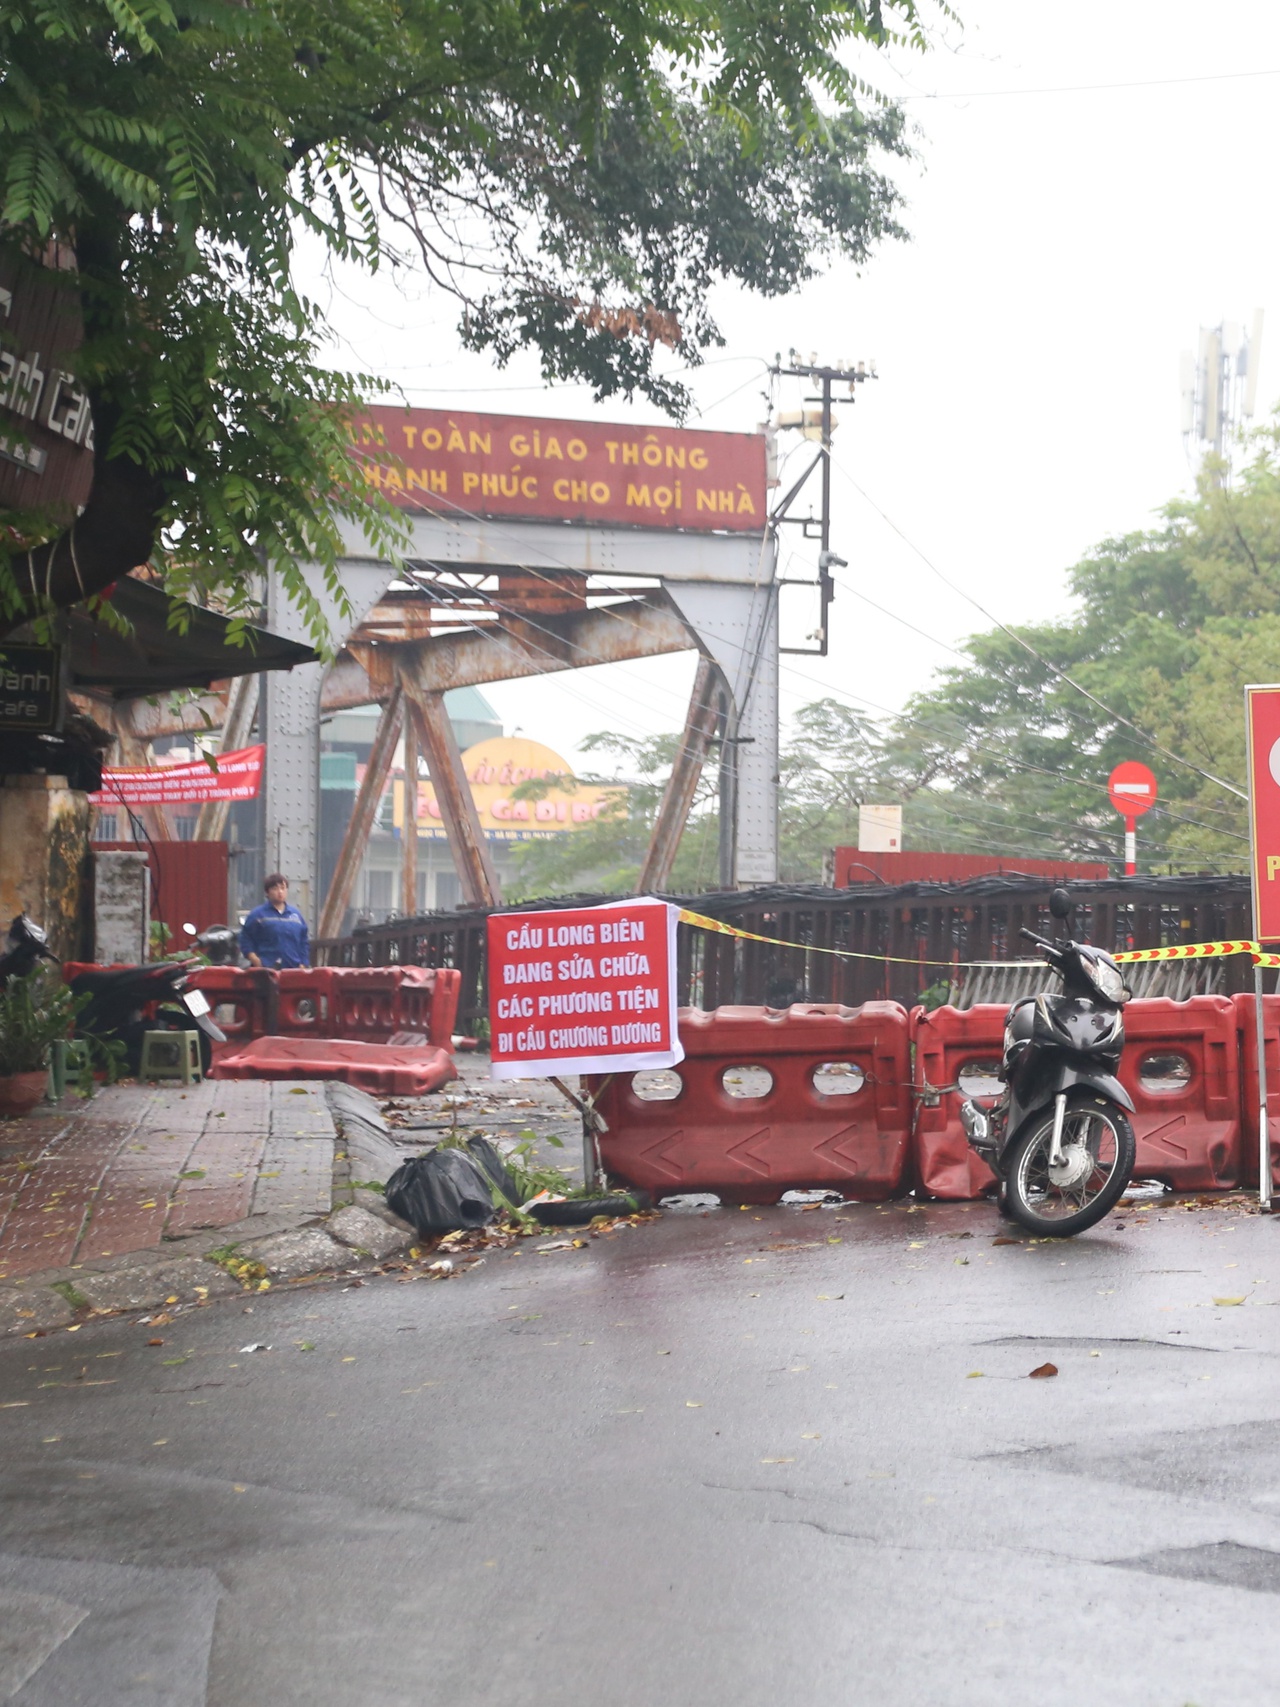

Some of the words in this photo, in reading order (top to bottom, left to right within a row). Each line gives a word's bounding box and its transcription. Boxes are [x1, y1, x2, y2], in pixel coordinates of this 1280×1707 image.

[403, 420, 492, 455] TOÀN
[510, 434, 588, 462] GIAO
[606, 435, 709, 470] THÔNG
[363, 464, 448, 498] HẠNH
[463, 465, 538, 500] PHÚC
[553, 478, 611, 505] CHO
[626, 481, 682, 517] MỌI
[696, 483, 757, 516] NHÀ
[507, 922, 543, 950] CẦU
[548, 925, 595, 947] LONG
[600, 918, 645, 943] BIÊN
[503, 961, 553, 984] ĐANG
[558, 953, 595, 981] SỬA
[600, 952, 650, 978] CHỮA
[497, 994, 533, 1019] CÁC
[538, 991, 612, 1016] PHƯƠNG
[617, 986, 659, 1014] TIỆN
[498, 1032, 513, 1053] ĐI
[516, 1024, 546, 1051] CẦU
[550, 1026, 608, 1049] CHƯƠNG
[611, 1022, 661, 1045] DƯƠNG
